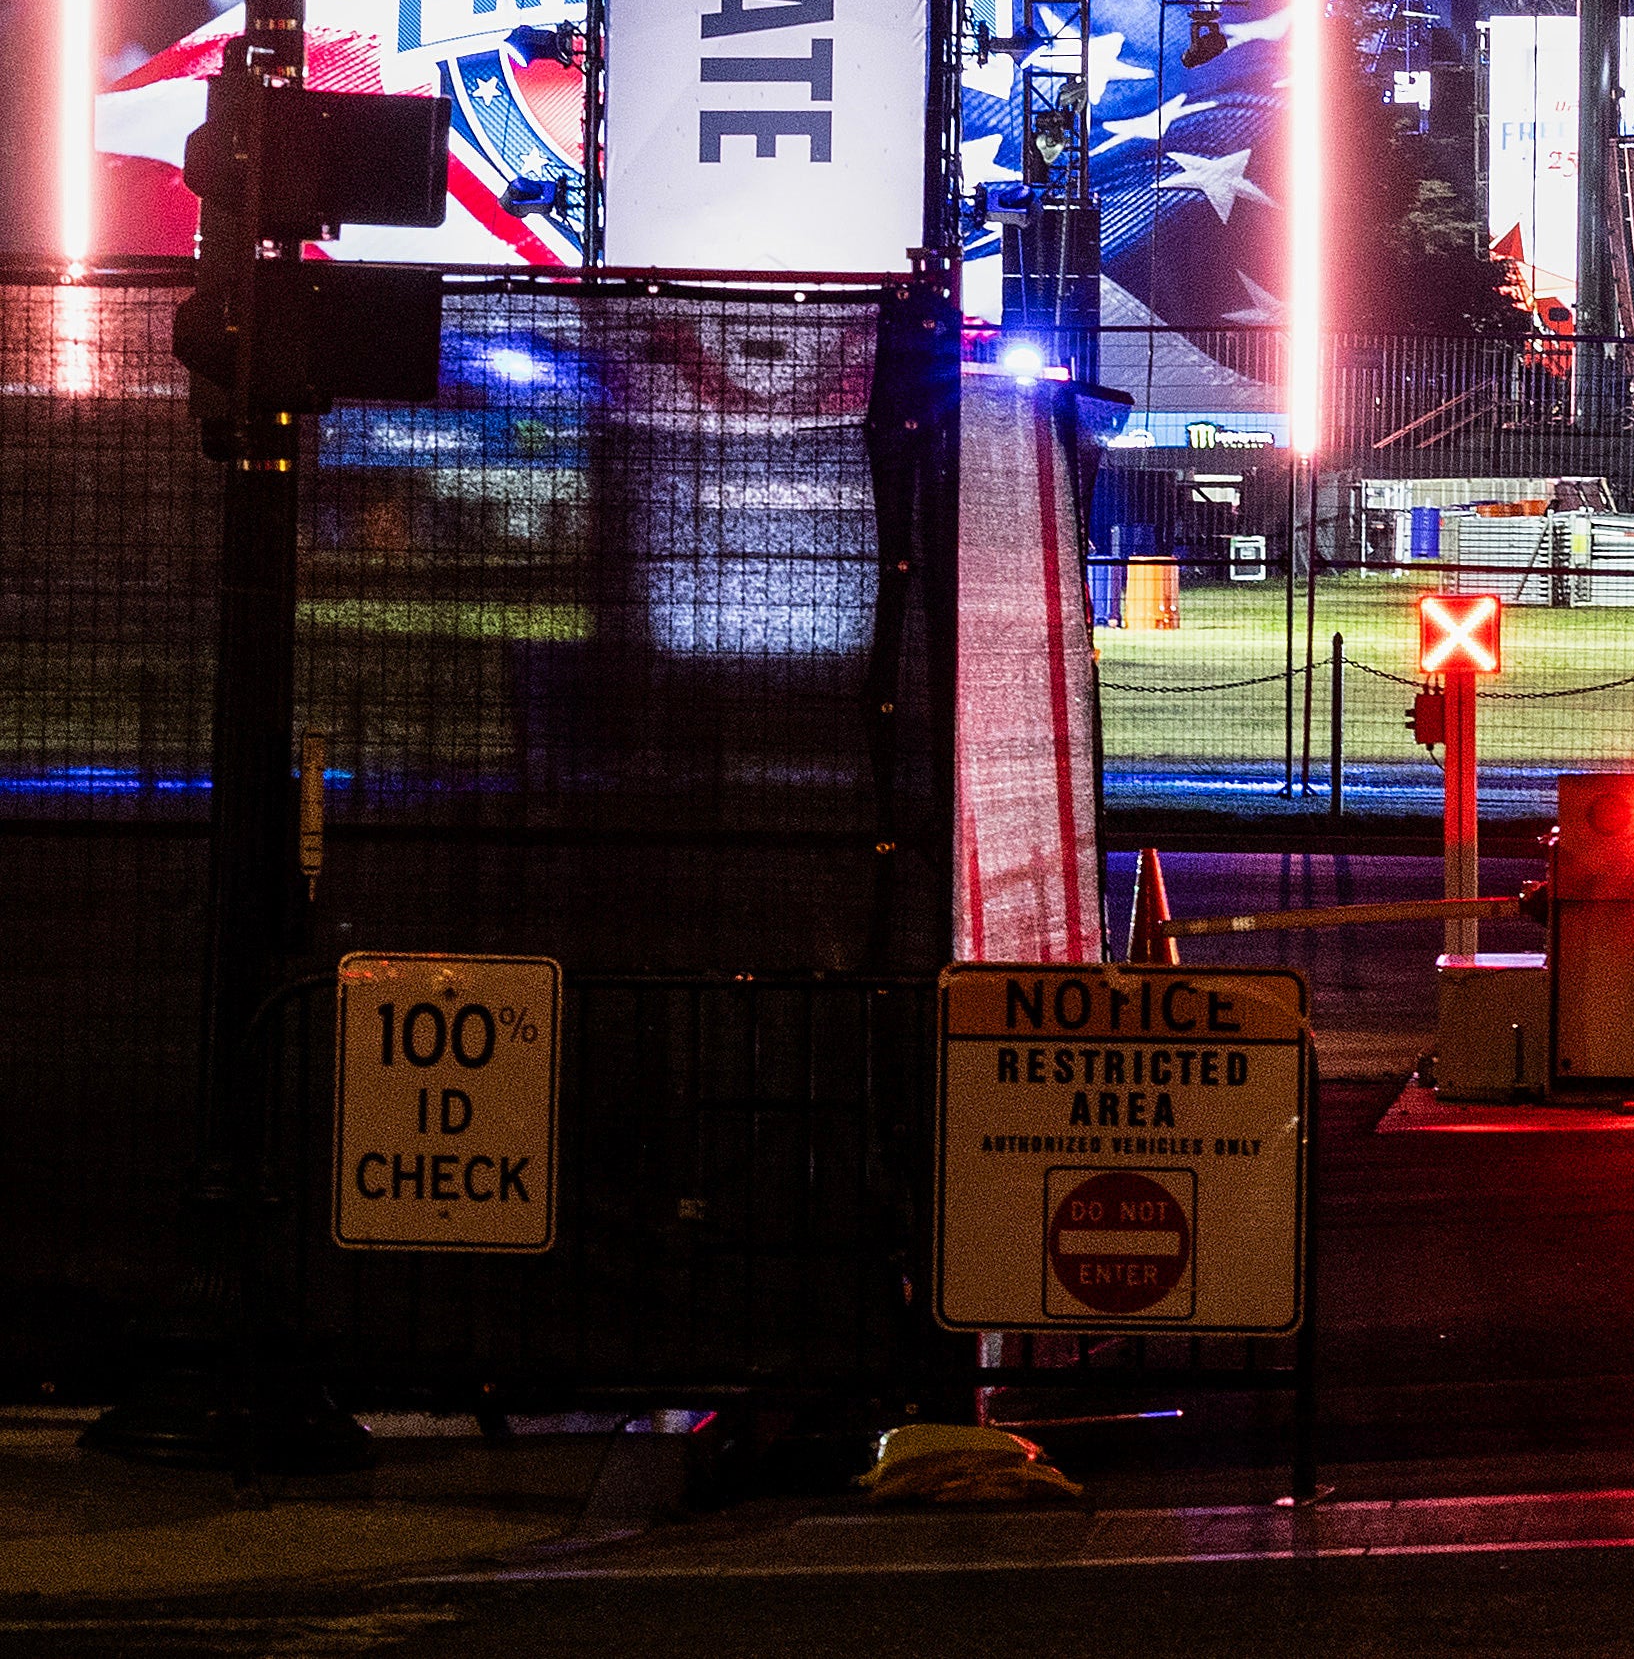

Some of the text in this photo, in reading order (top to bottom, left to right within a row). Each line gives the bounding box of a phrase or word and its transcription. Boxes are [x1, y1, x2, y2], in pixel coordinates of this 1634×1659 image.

[1006, 980, 1240, 1032] NOTICE
[378, 1003, 537, 1068] 100%
[998, 1049, 1249, 1086] RESTRICTED
[419, 1089, 472, 1134] ID
[1070, 1092, 1176, 1128] AREA
[983, 1136, 1262, 1156] AUTHORIZED VEHICLES ONLY
[357, 1153, 529, 1202] CHECK
[1071, 1200, 1168, 1222] DO NOT
[1079, 1263, 1158, 1286] ENTER
